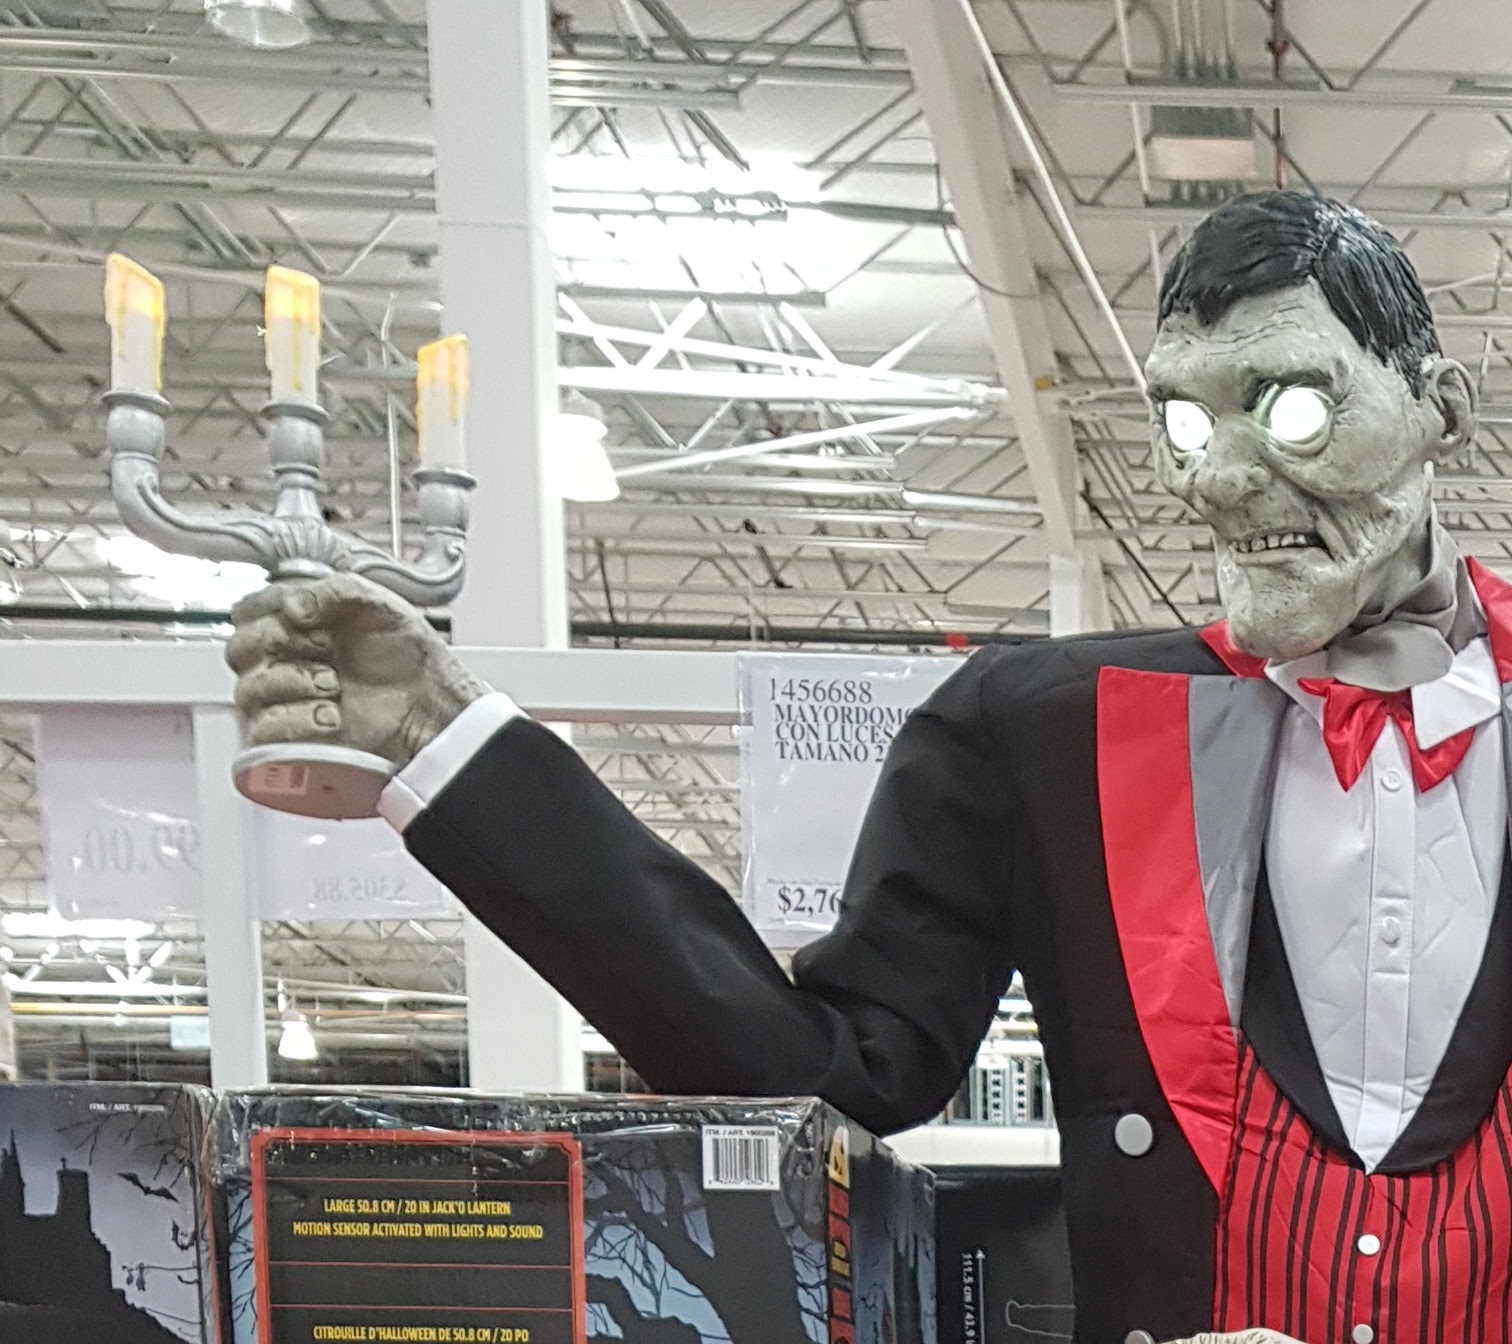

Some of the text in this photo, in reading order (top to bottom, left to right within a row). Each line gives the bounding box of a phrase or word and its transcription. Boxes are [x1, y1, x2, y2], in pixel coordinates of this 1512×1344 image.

[770, 678, 872, 704] 1456688
[775, 722, 894, 745] CON LUCES
[778, 887, 842, 917] $2,76
[324, 1199, 355, 1214] LARGE
[357, 1199, 379, 1214] 50.8
[381, 1200, 395, 1214] CM
[404, 1200, 416, 1215] 20
[419, 1200, 429, 1215] IN
[468, 1201, 510, 1215] LANTERN
[293, 1222, 543, 1239] MOTION SENSOR ACTIVATED WITH LIGHTS AND SOUND
